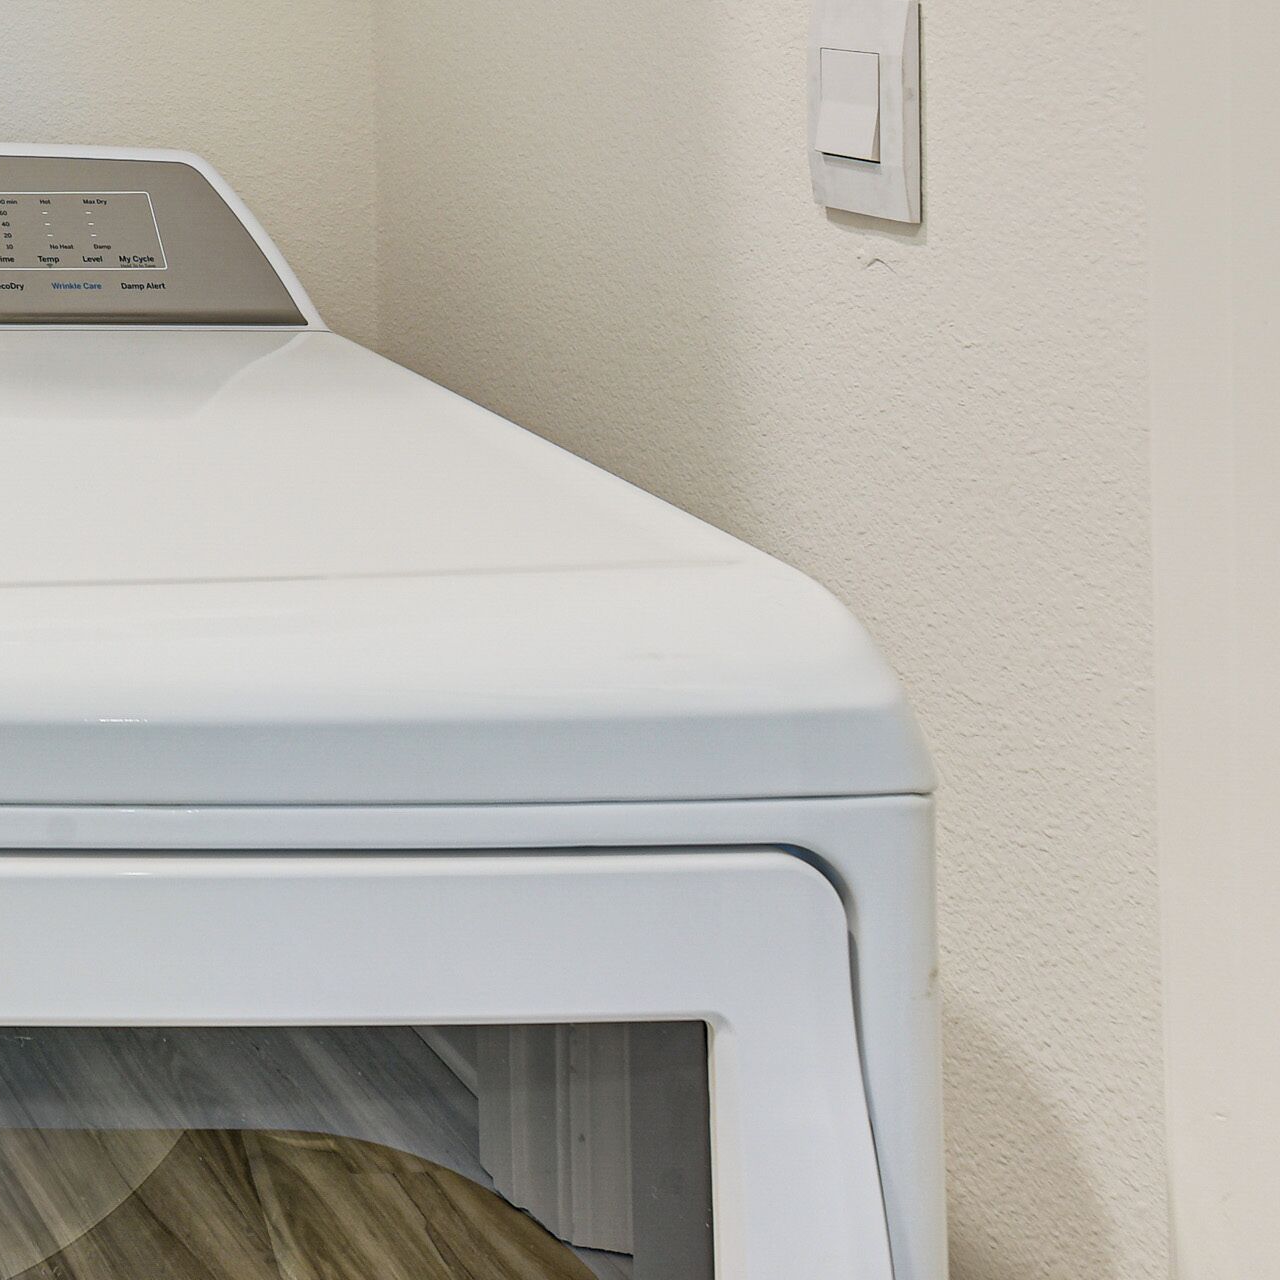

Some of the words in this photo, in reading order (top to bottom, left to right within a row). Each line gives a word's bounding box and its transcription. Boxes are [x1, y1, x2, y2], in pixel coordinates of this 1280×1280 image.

[37, 255, 60, 264] Temp
[119, 255, 131, 263] My
[132, 255, 155, 263] Cycle
[51, 282, 82, 290] Wrinkle
[121, 282, 145, 291] Damp
